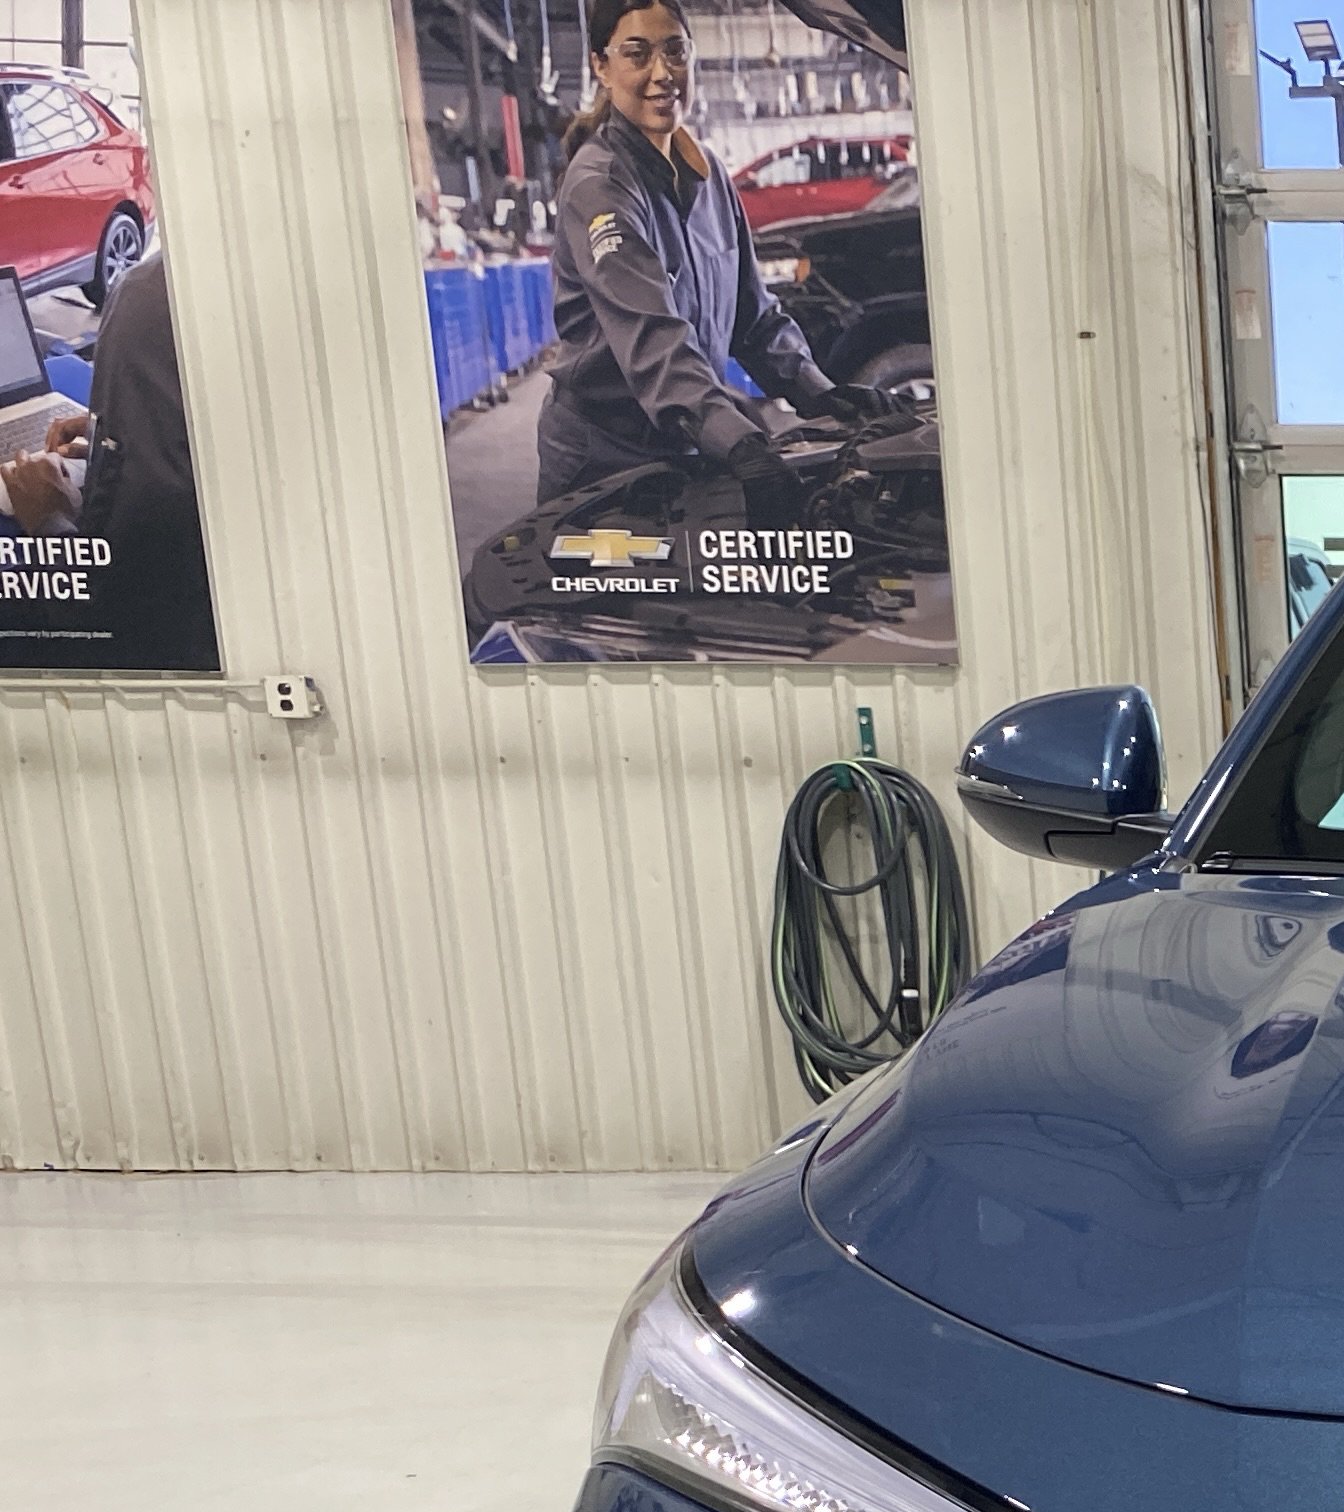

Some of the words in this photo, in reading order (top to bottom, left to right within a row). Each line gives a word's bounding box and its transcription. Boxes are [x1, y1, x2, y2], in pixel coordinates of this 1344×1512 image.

[699, 530, 854, 559] CERTIFIED
[0, 571, 90, 600] RVICE
[551, 577, 680, 593] CHEVROLET
[703, 565, 831, 593] SERVICE
